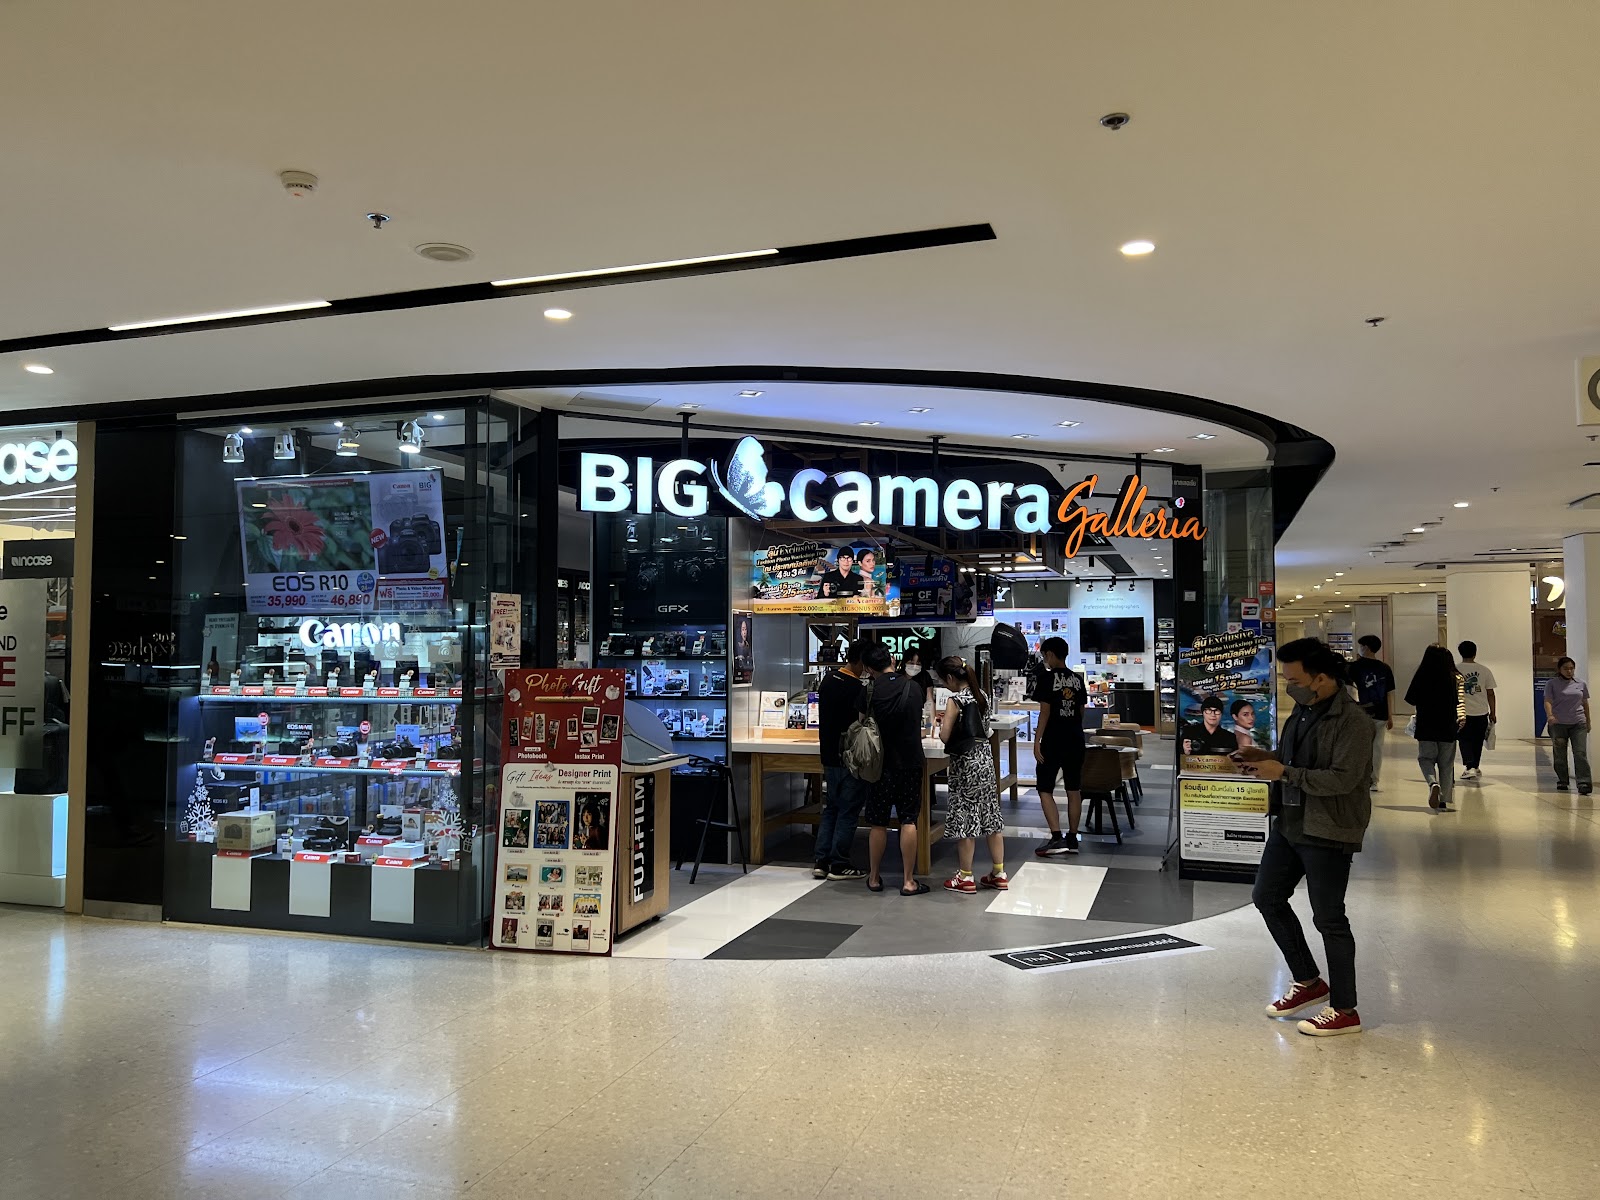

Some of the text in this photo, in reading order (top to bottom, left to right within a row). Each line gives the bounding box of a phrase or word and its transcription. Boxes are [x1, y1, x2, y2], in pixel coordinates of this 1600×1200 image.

[580, 452, 1052, 534] BIG camera
[1057, 474, 1208, 559] Galleria
[371, 532, 385, 544] NEW
[780, 542, 816, 556] Exclusive
[18, 555, 52, 566] incase
[777, 571, 782, 579] 4
[791, 569, 798, 578] 3
[272, 574, 348, 592] EOS R10
[918, 590, 932, 599] CF
[299, 619, 400, 648] Canon
[1208, 630, 1254, 644] Exclusive
[1182, 650, 1204, 658] Fashion
[1223, 640, 1253, 649] Workshop
[1254, 637, 1268, 645] Trip
[1194, 636, 1207, 650] ลุ้น
[1200, 646, 1258, 663] ประเทศมัลดีฟส์
[1206, 662, 1214, 672] 4
[1225, 660, 1233, 668] 3
[1234, 658, 1244, 667] คืน
[526, 673, 604, 695] Photo Gift
[1215, 674, 1226, 682] 15
[1220, 680, 1236, 690] 2.5
[506, 769, 553, 784] Gift Ideas
[558, 769, 612, 778] Designer Print
[634, 778, 644, 902] FUJIFILM
